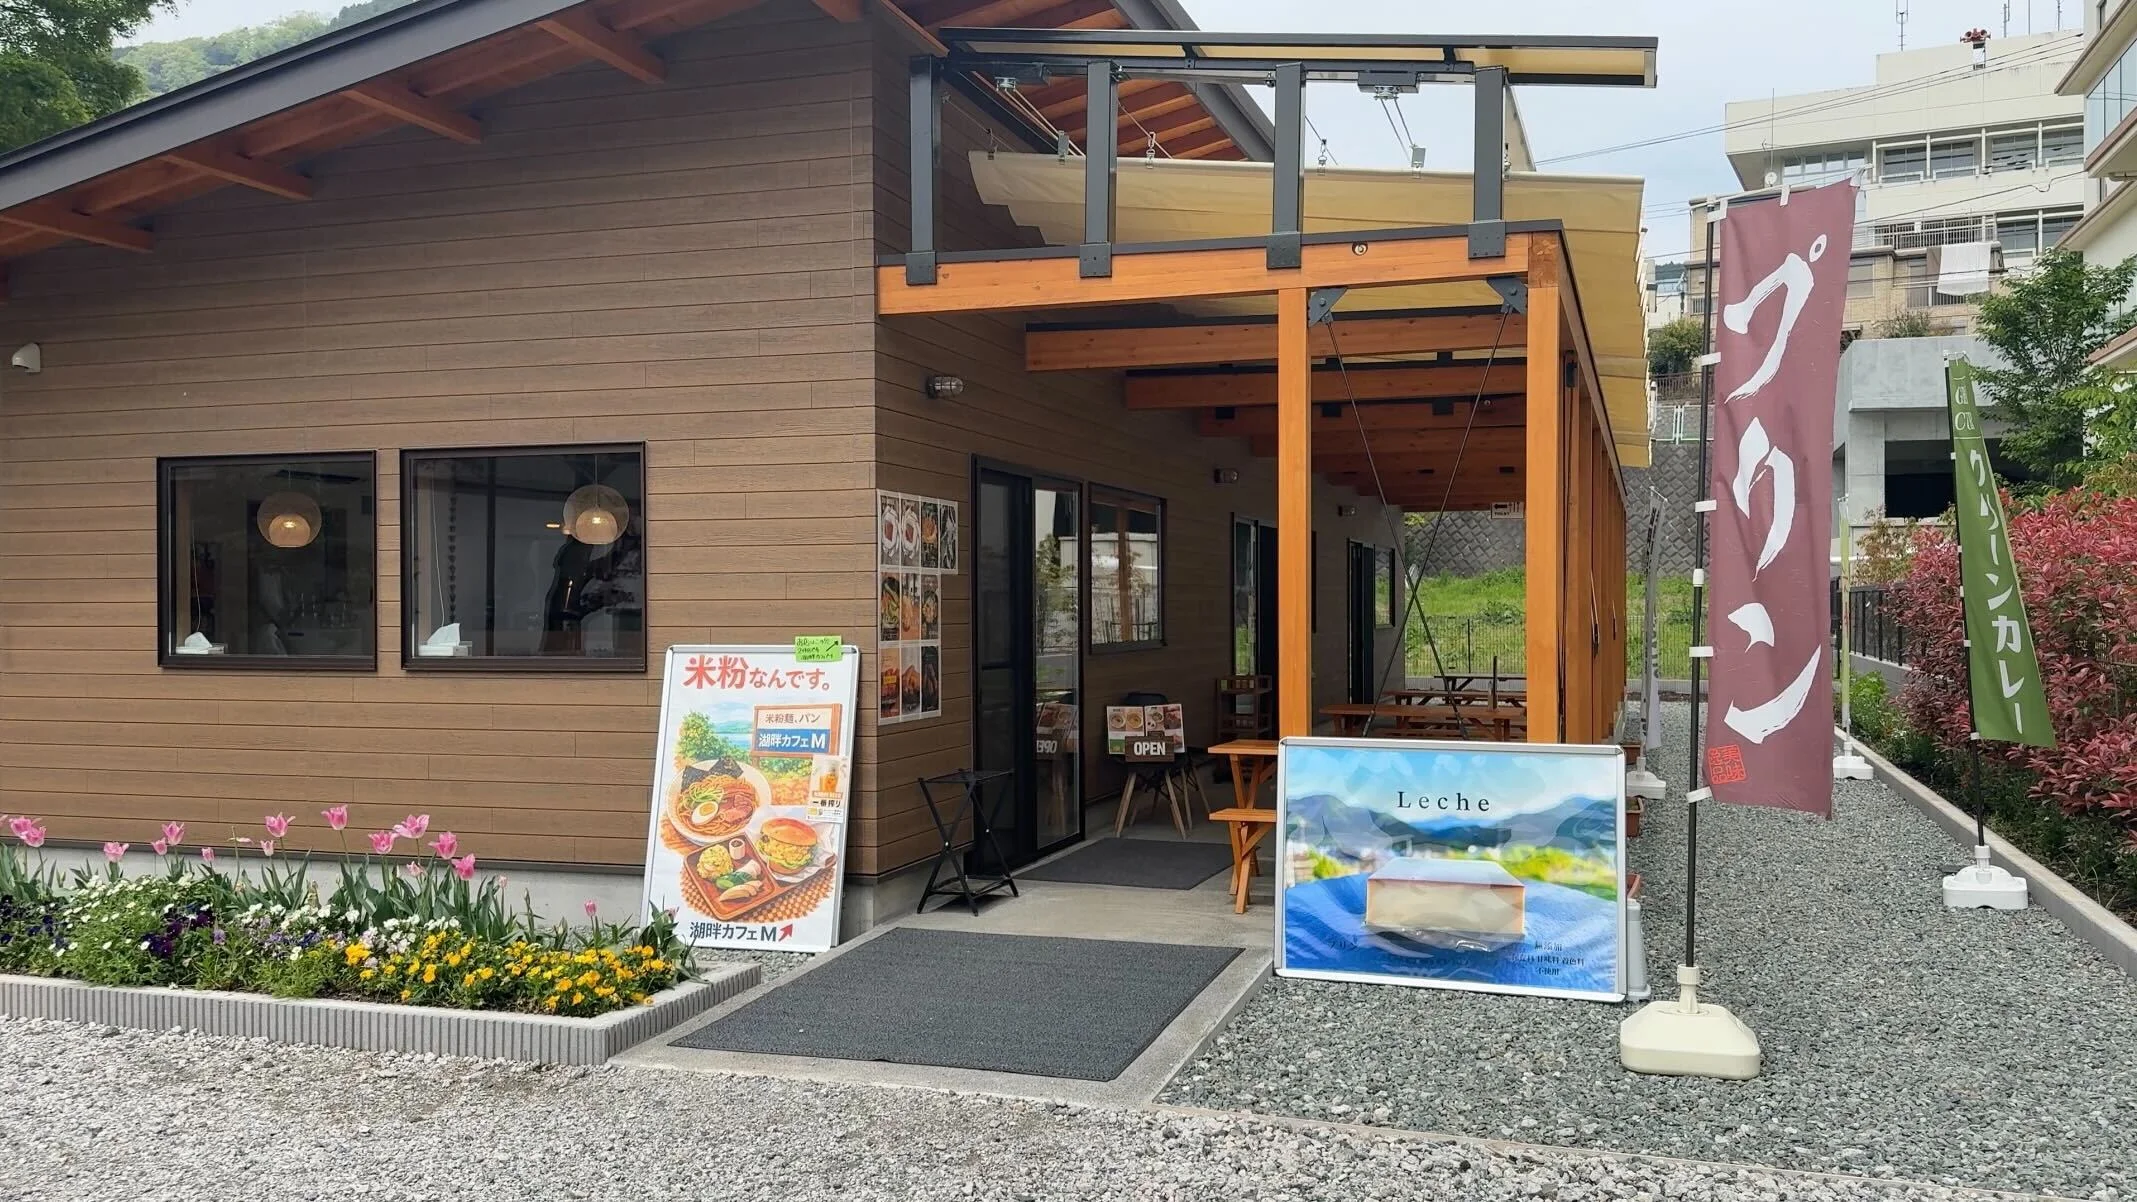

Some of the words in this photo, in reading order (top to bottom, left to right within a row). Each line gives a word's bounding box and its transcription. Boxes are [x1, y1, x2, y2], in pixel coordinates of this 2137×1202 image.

[1723, 232, 1829, 744] プリン
[682, 655, 830, 691] 米粉なんです。
[1133, 741, 1166, 756] OPEN
[1397, 790, 1490, 812] Leche
[689, 921, 777, 942] 湖畔カフェM
